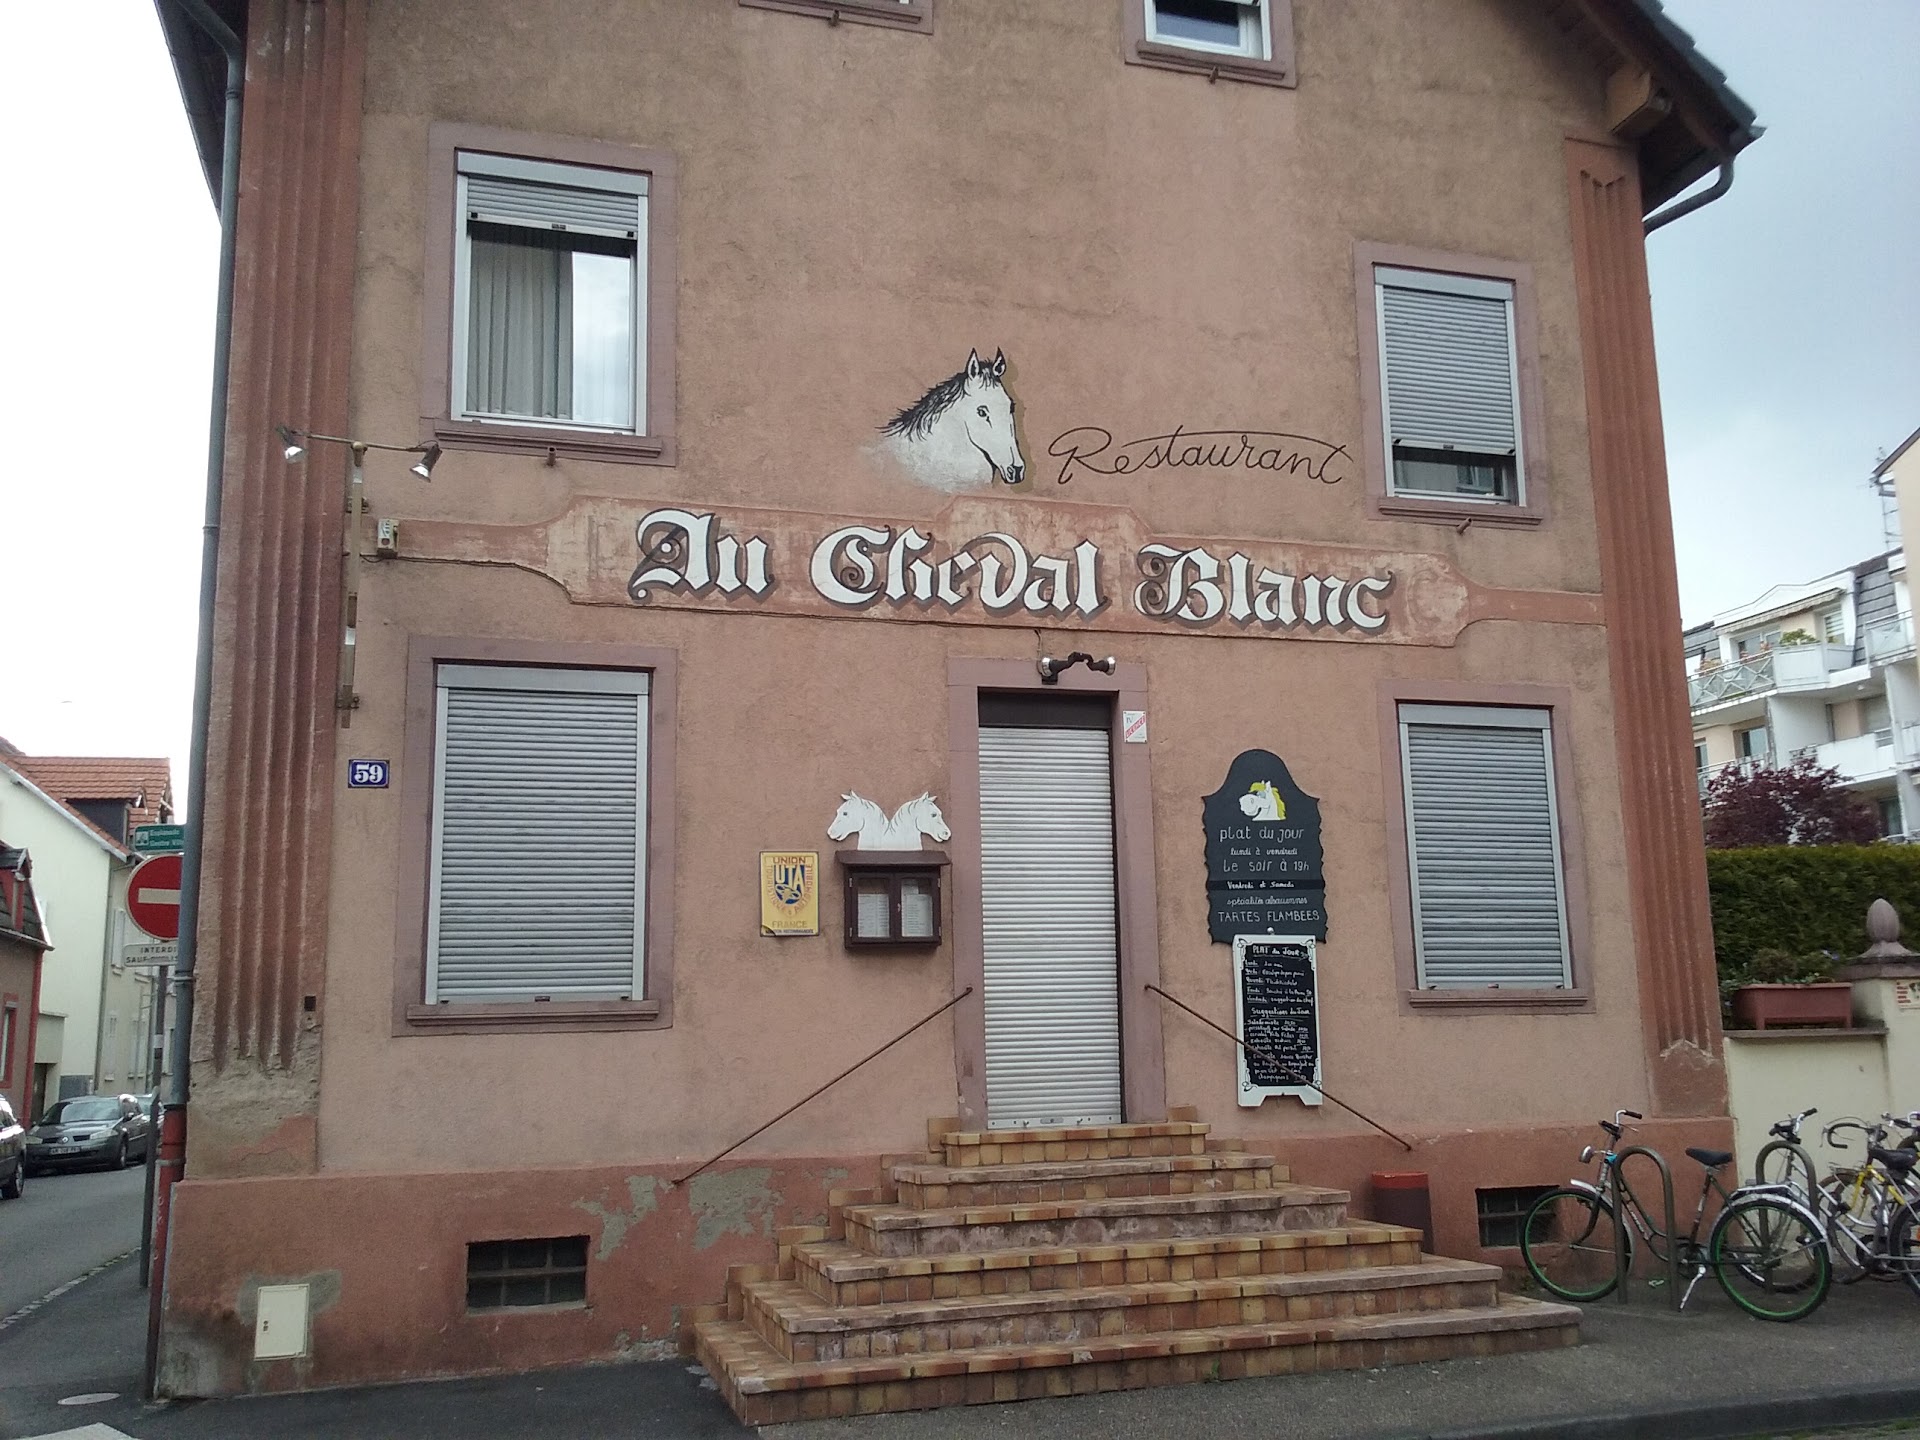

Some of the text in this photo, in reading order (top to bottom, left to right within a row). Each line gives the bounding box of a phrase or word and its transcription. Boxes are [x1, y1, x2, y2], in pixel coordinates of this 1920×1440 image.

[1047, 425, 1354, 485] Restaurant
[630, 507, 1395, 631] Au Cheval Blanc
[354, 763, 384, 784] 59
[1219, 825, 1305, 843] plat du jour
[1230, 847, 1252, 856] lundi
[1266, 847, 1298, 856] vendredi
[773, 856, 807, 864] UNION
[1223, 858, 1310, 873] Le soir à 19h
[774, 864, 806, 897] UTA
[1227, 880, 1254, 890] Vendredi
[1259, 880, 1267, 889] et
[1217, 909, 1320, 922] TARTES FLAMBEES
[771, 920, 808, 929] FRANCE
[140, 946, 177, 954] INTERDI
[1252, 945, 1270, 954] PLAT
